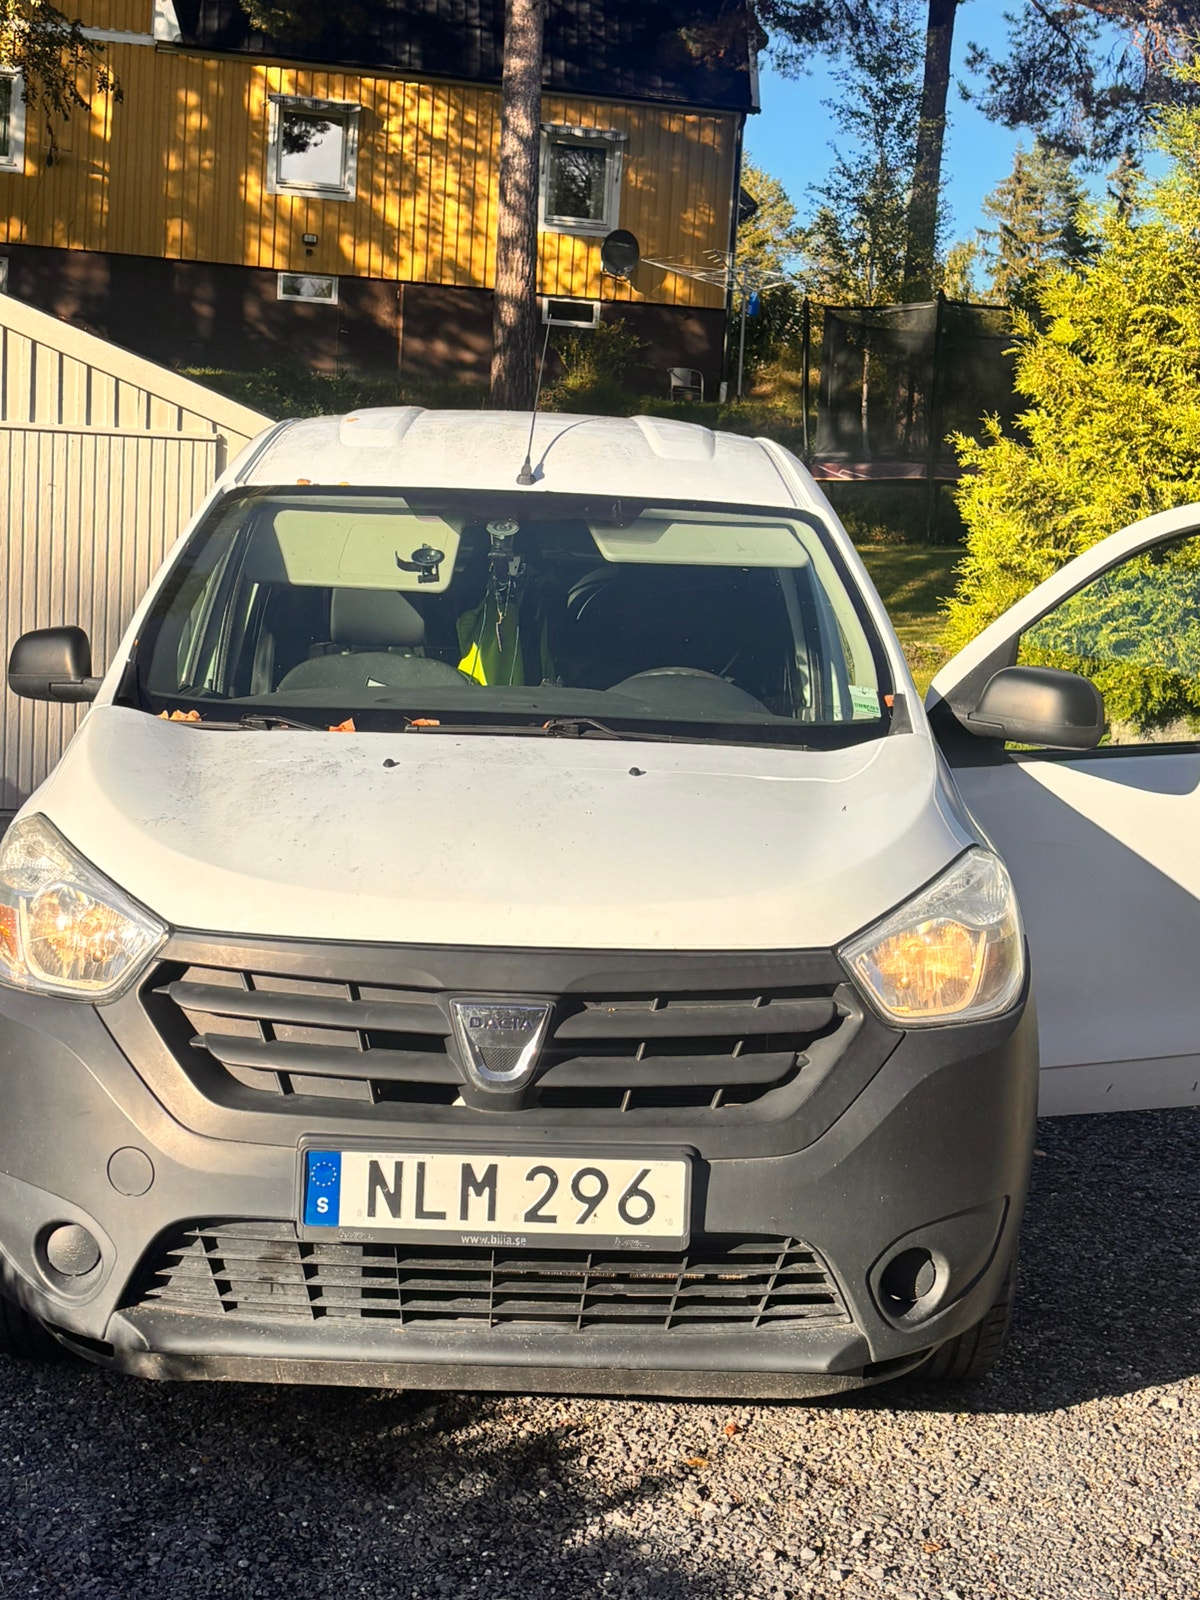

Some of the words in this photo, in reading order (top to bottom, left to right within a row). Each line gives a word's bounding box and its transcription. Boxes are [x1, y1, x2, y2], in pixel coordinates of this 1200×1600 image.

[469, 1016, 534, 1030] DACIA
[367, 1160, 498, 1222] NLM
[524, 1165, 656, 1226] 296
[316, 1196, 329, 1214] S
[460, 1234, 527, 1246] www.bilia.se
